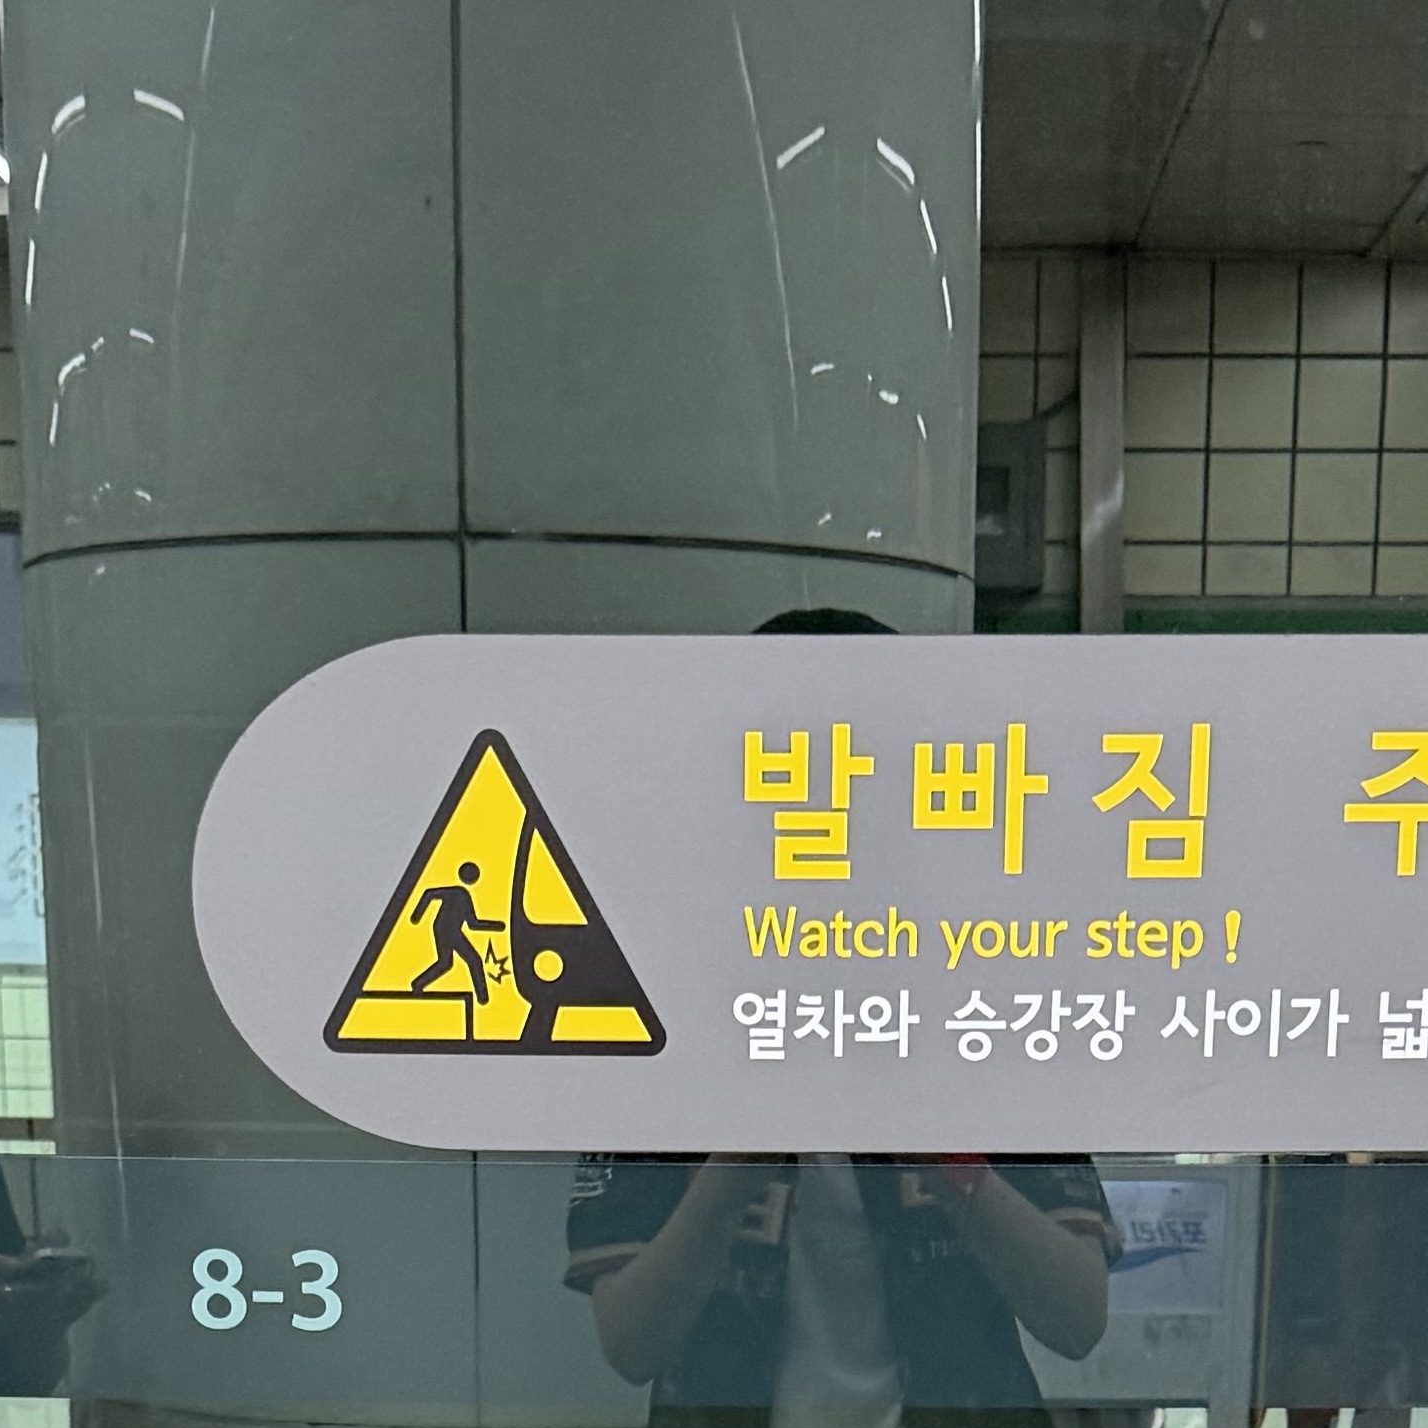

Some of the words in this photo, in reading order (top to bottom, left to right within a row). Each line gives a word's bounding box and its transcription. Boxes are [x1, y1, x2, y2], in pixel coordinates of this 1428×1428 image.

[743, 905, 920, 960] Watch
[939, 919, 1068, 971] your
[732, 987, 921, 1062] 열차와
[944, 988, 1136, 1063] 승강장
[1160, 988, 1350, 1060] 사이가
[191, 1248, 343, 1331] 8-3
